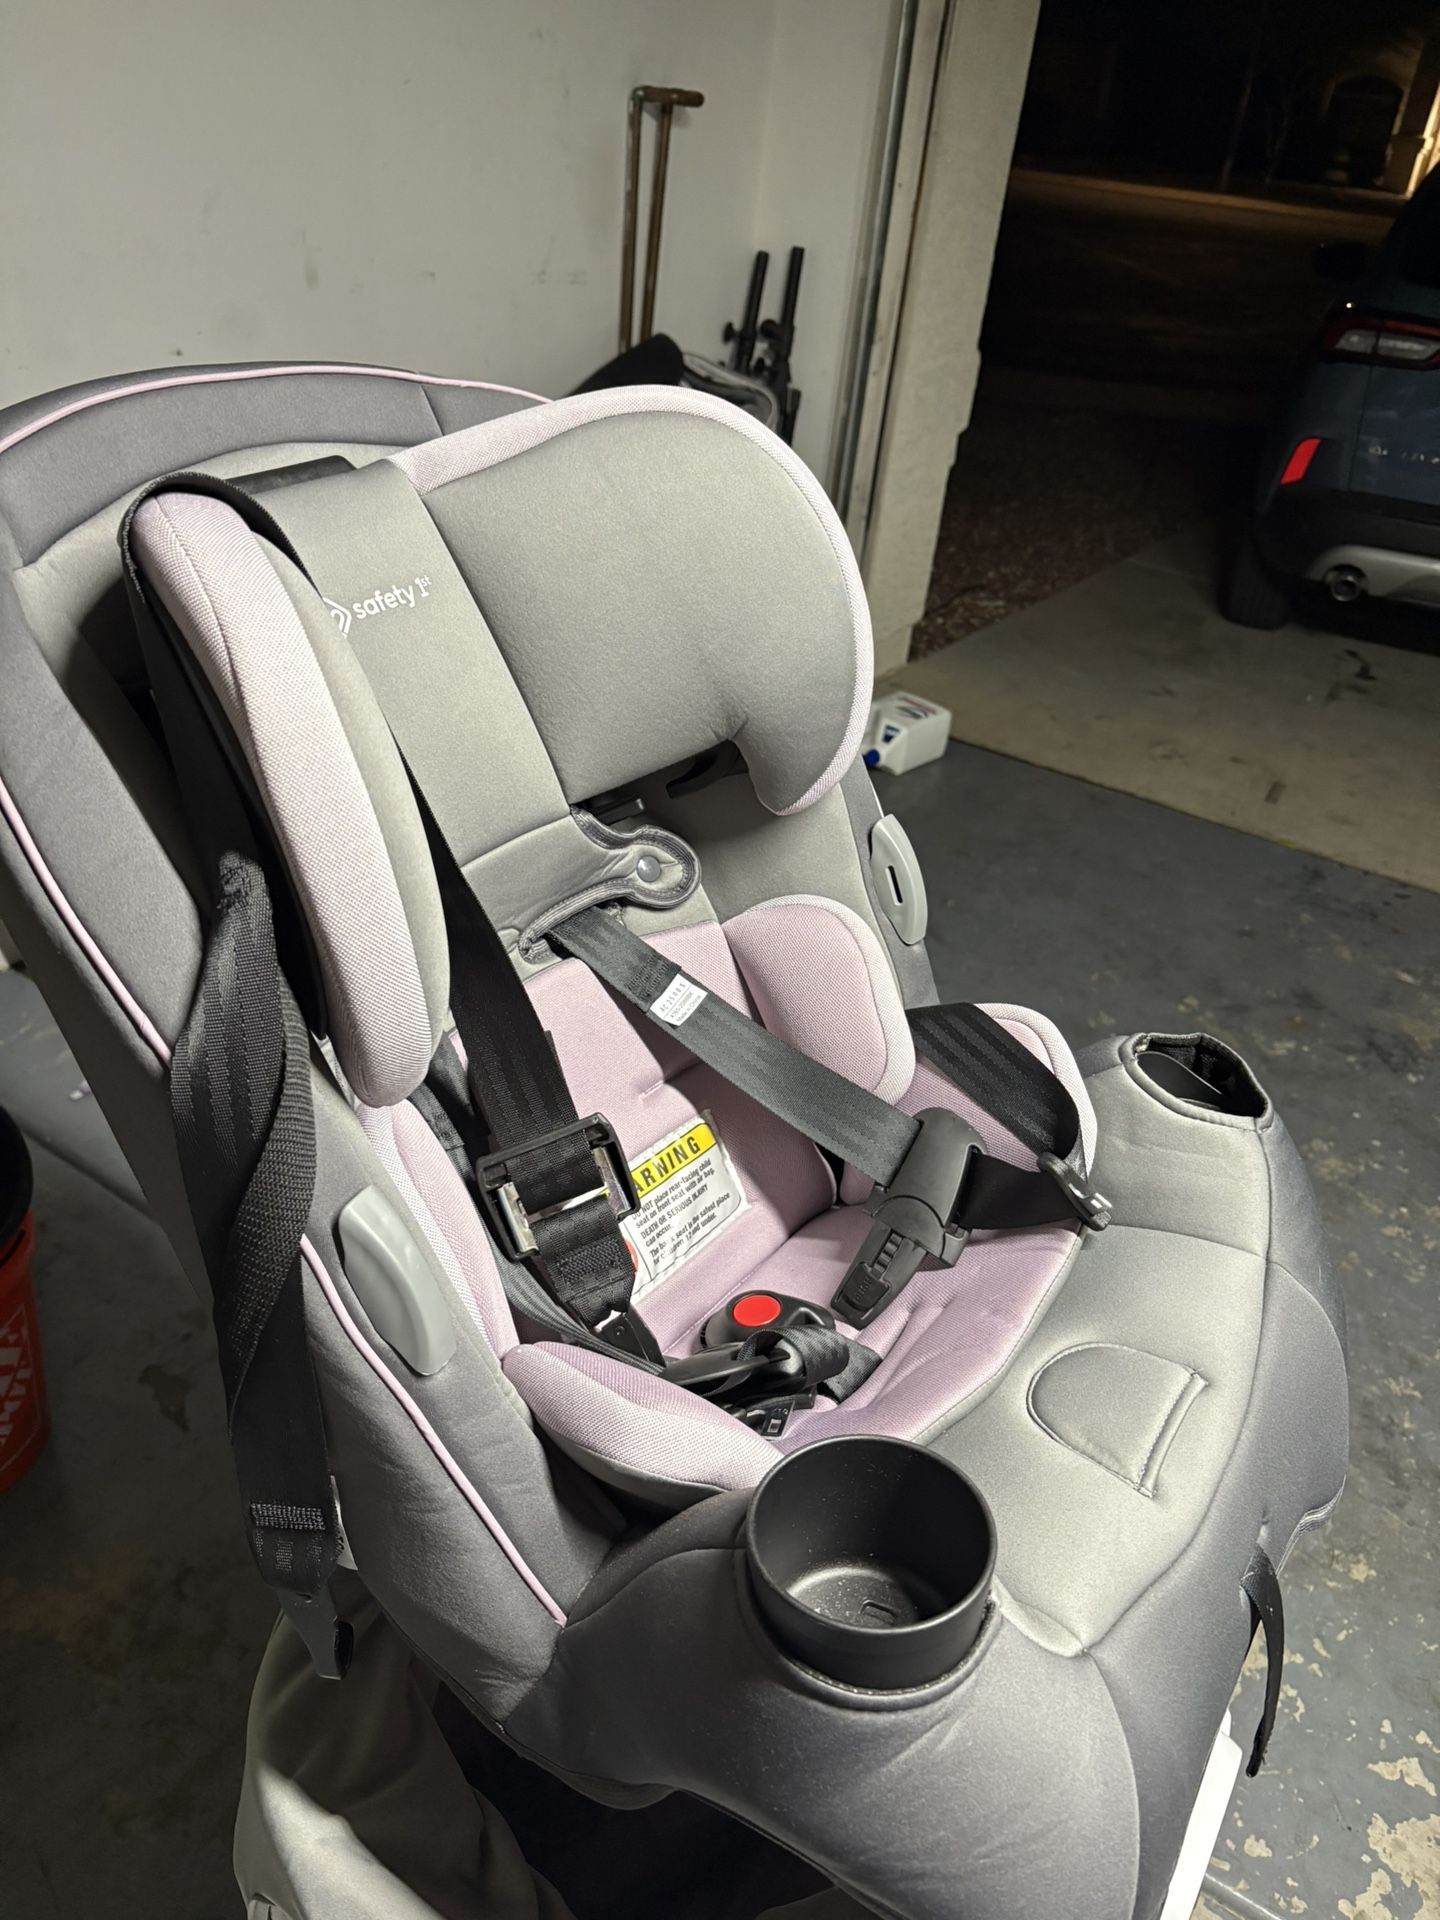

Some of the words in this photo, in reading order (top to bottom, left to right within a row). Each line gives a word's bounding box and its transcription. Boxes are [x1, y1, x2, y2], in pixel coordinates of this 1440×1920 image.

[352, 585, 415, 619] safety
[414, 575, 432, 598] 1st
[635, 1136, 701, 1193] ARNING
[641, 1200, 653, 1213] NOT
[653, 1189, 669, 1205] place
[698, 1158, 711, 1171] child
[636, 1213, 650, 1228] seat
[671, 1188, 685, 1202] seat
[640, 1221, 659, 1239] DEATH
[658, 1214, 667, 1225] OR
[667, 1197, 693, 1219] SERIOUS
[650, 1247, 660, 1257] The
[675, 1224, 688, 1238] seat
[700, 1201, 715, 1217] safest
[716, 1192, 730, 1206] place
[646, 1237, 655, 1247] can
